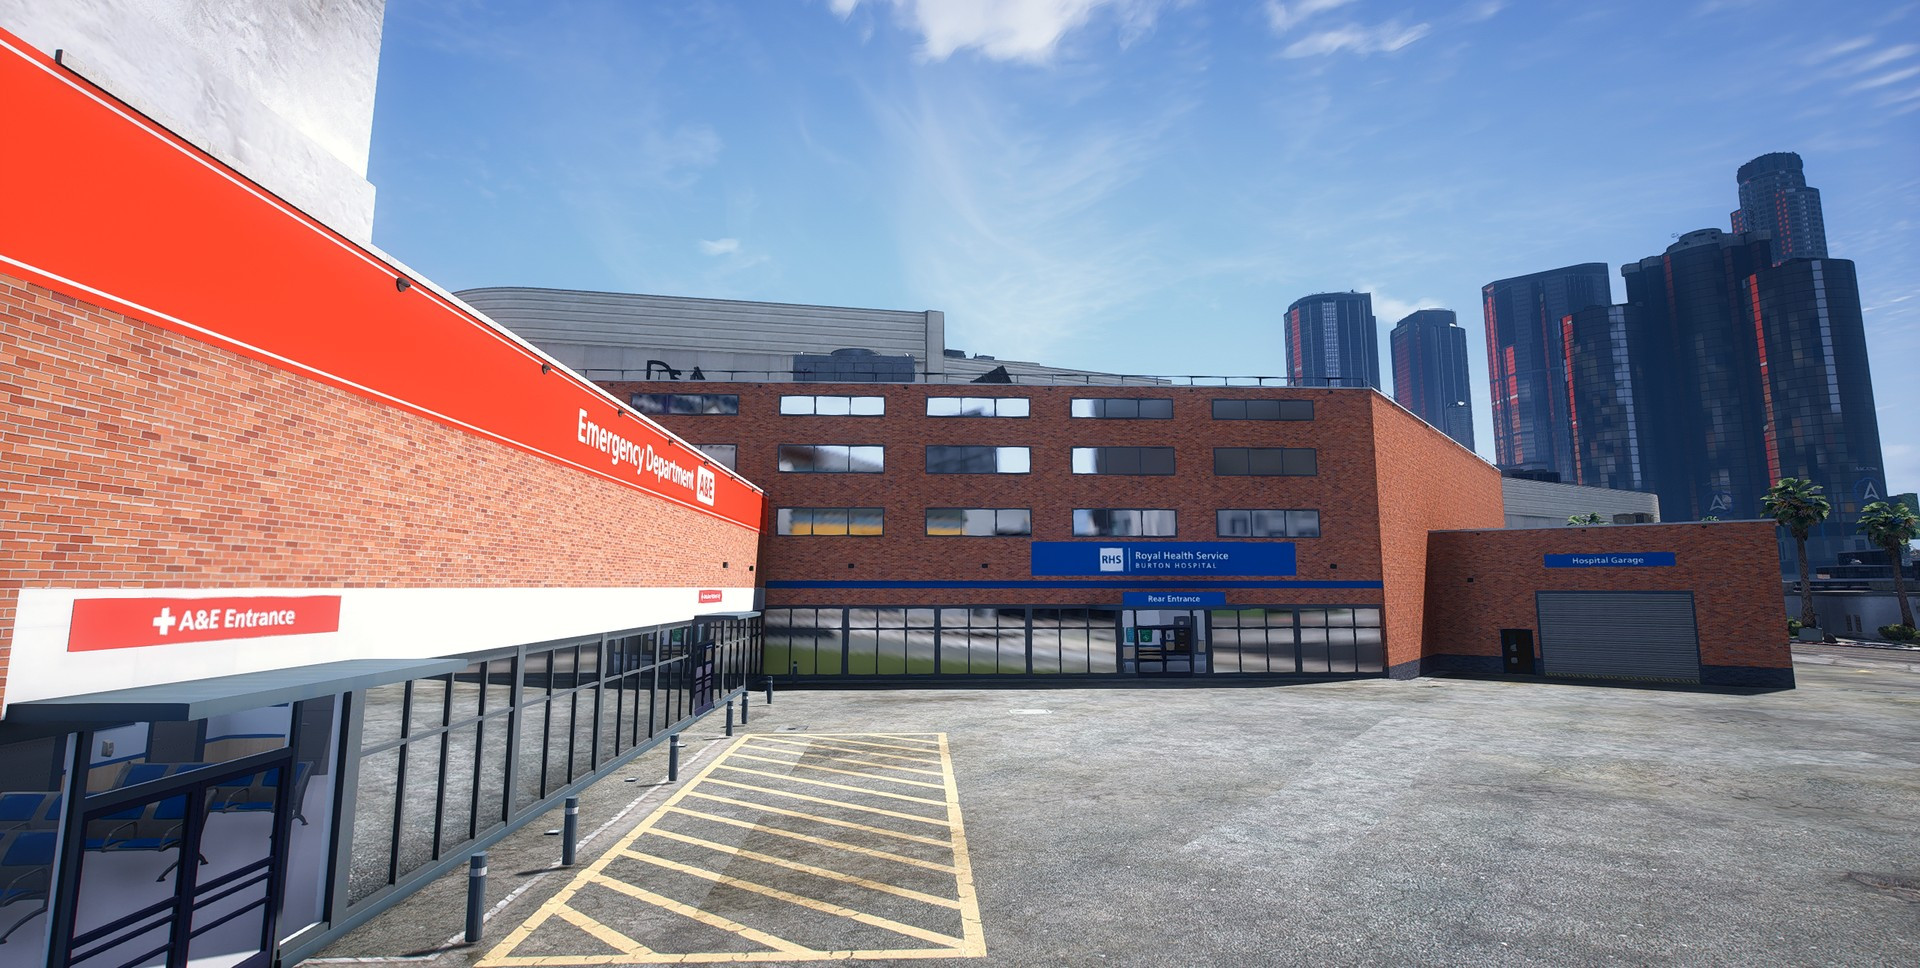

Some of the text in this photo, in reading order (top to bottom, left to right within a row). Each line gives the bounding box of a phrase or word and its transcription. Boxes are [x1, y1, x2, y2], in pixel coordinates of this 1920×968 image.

[578, 408, 713, 500] Emergency Department A&E
[1101, 551, 1229, 564] RHS Royal Health Service
[1572, 557, 1644, 565] Hospital Garage
[178, 608, 296, 631] A&E Entrance
